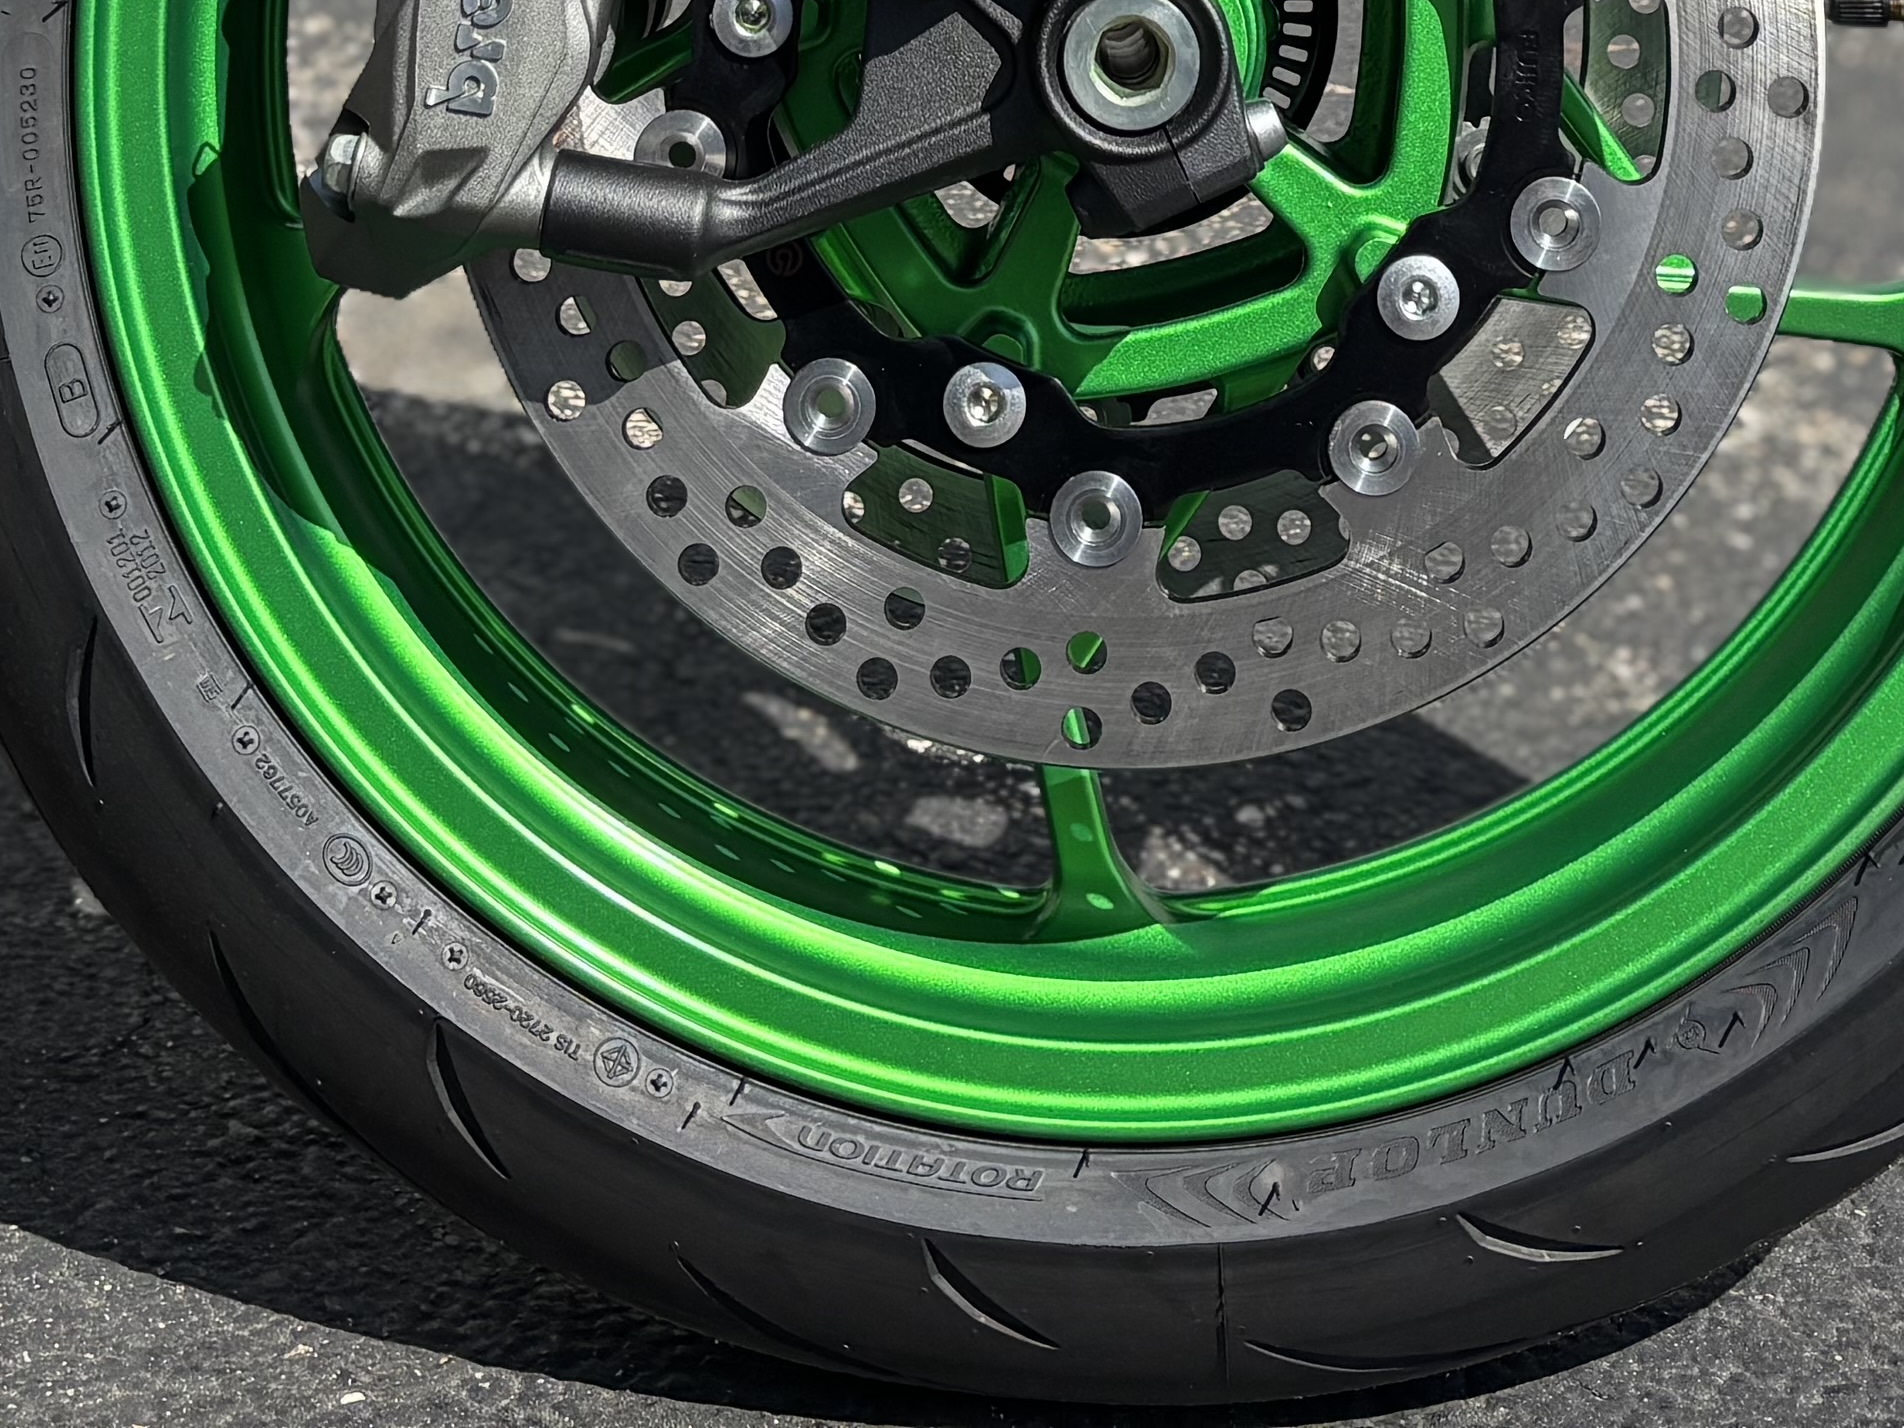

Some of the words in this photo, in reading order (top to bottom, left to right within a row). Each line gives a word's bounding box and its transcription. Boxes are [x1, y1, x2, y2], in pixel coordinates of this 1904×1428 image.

[18, 66, 47, 224] 75R-005230
[54, 374, 89, 405] B
[105, 527, 151, 604] 001201
[127, 528, 167, 581] 2012
[253, 753, 317, 828] A057762
[463, 972, 555, 1042] 2720-2560
[550, 1030, 584, 1062] TIS
[1307, 1050, 1639, 1194] DUNLOP
[796, 1123, 1042, 1193] ROTATION
